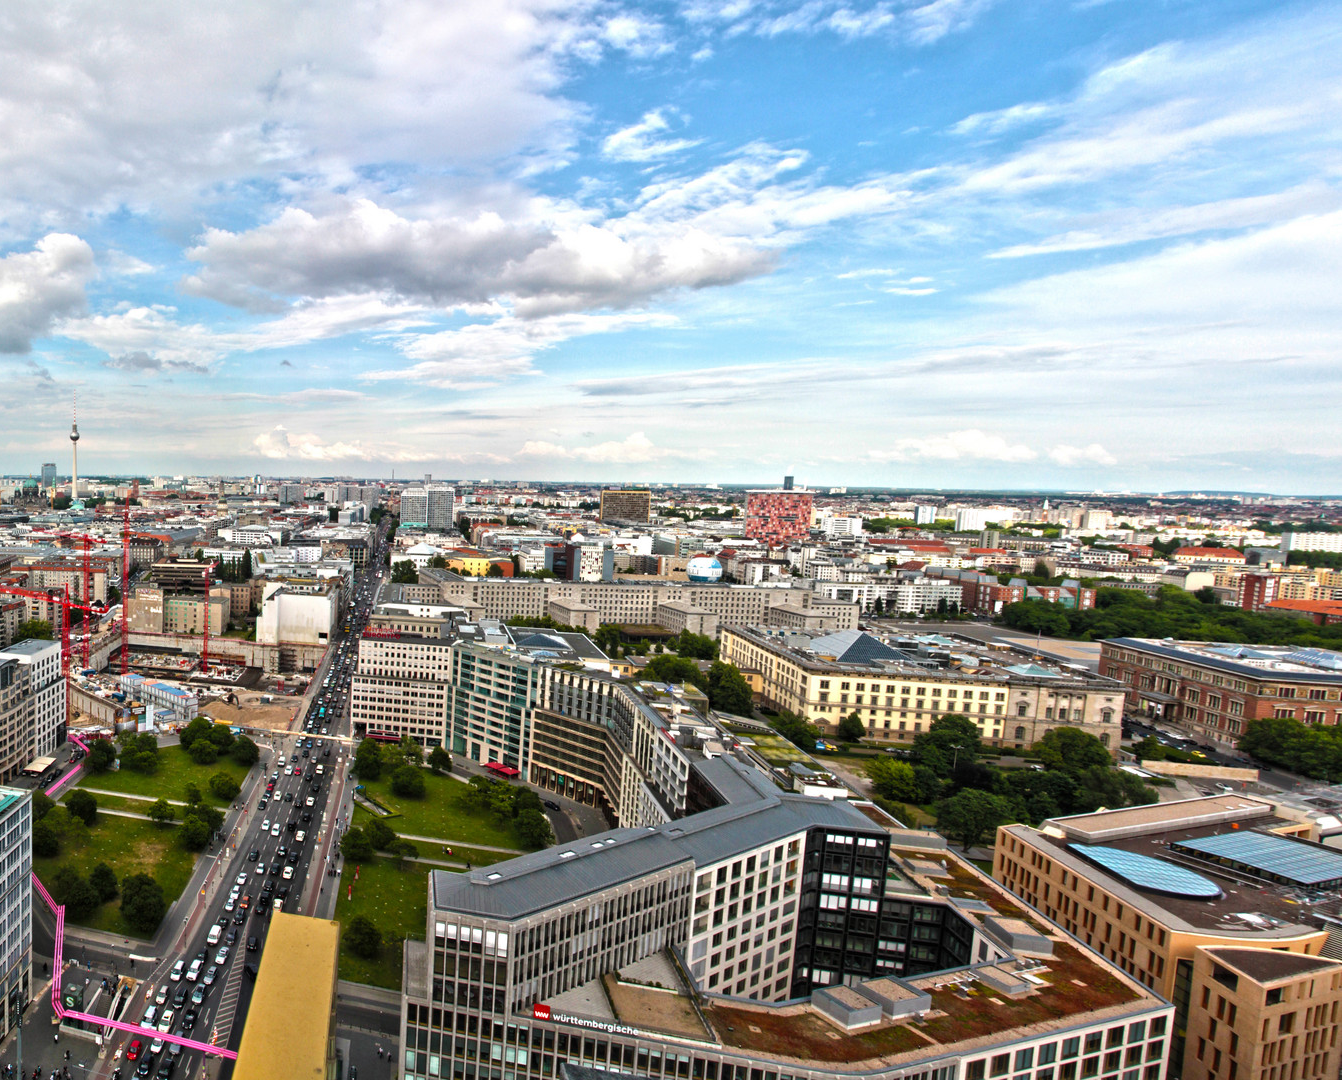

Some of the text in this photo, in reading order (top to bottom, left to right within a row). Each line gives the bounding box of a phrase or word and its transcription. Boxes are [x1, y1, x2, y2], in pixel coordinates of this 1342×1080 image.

[362, 631, 401, 640] EUROHYPO
[65, 996, 75, 1008] S
[552, 1013, 640, 1036] württembergische
